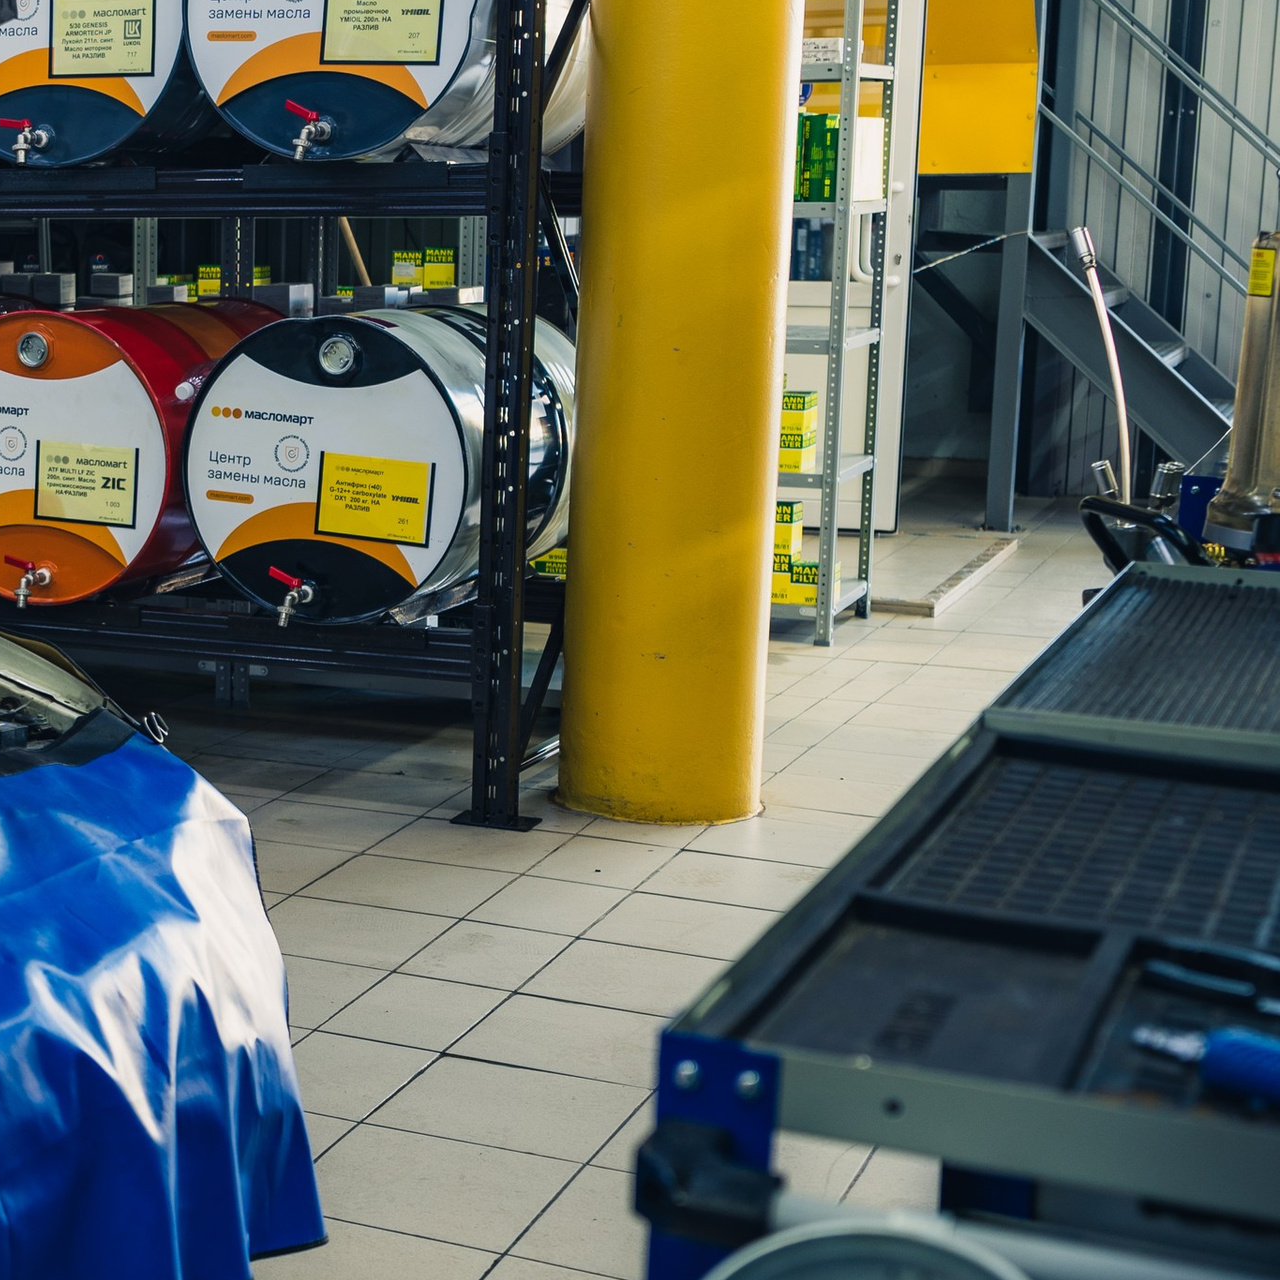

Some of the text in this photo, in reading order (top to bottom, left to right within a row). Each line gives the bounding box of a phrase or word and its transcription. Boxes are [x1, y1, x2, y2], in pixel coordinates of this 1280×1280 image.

[208, 8, 311, 19] замены масла
[0, 26, 38, 37] масла
[245, 410, 314, 426] масломарт
[209, 450, 252, 467] Центр
[101, 477, 126, 491] ZIC
[208, 469, 306, 488] замены масла
[336, 480, 367, 488] Антифриз
[47, 482, 96, 491] трансмиссионное
[352, 489, 387, 499] carboxylate
[345, 504, 370, 512] РАЗЛИВ
